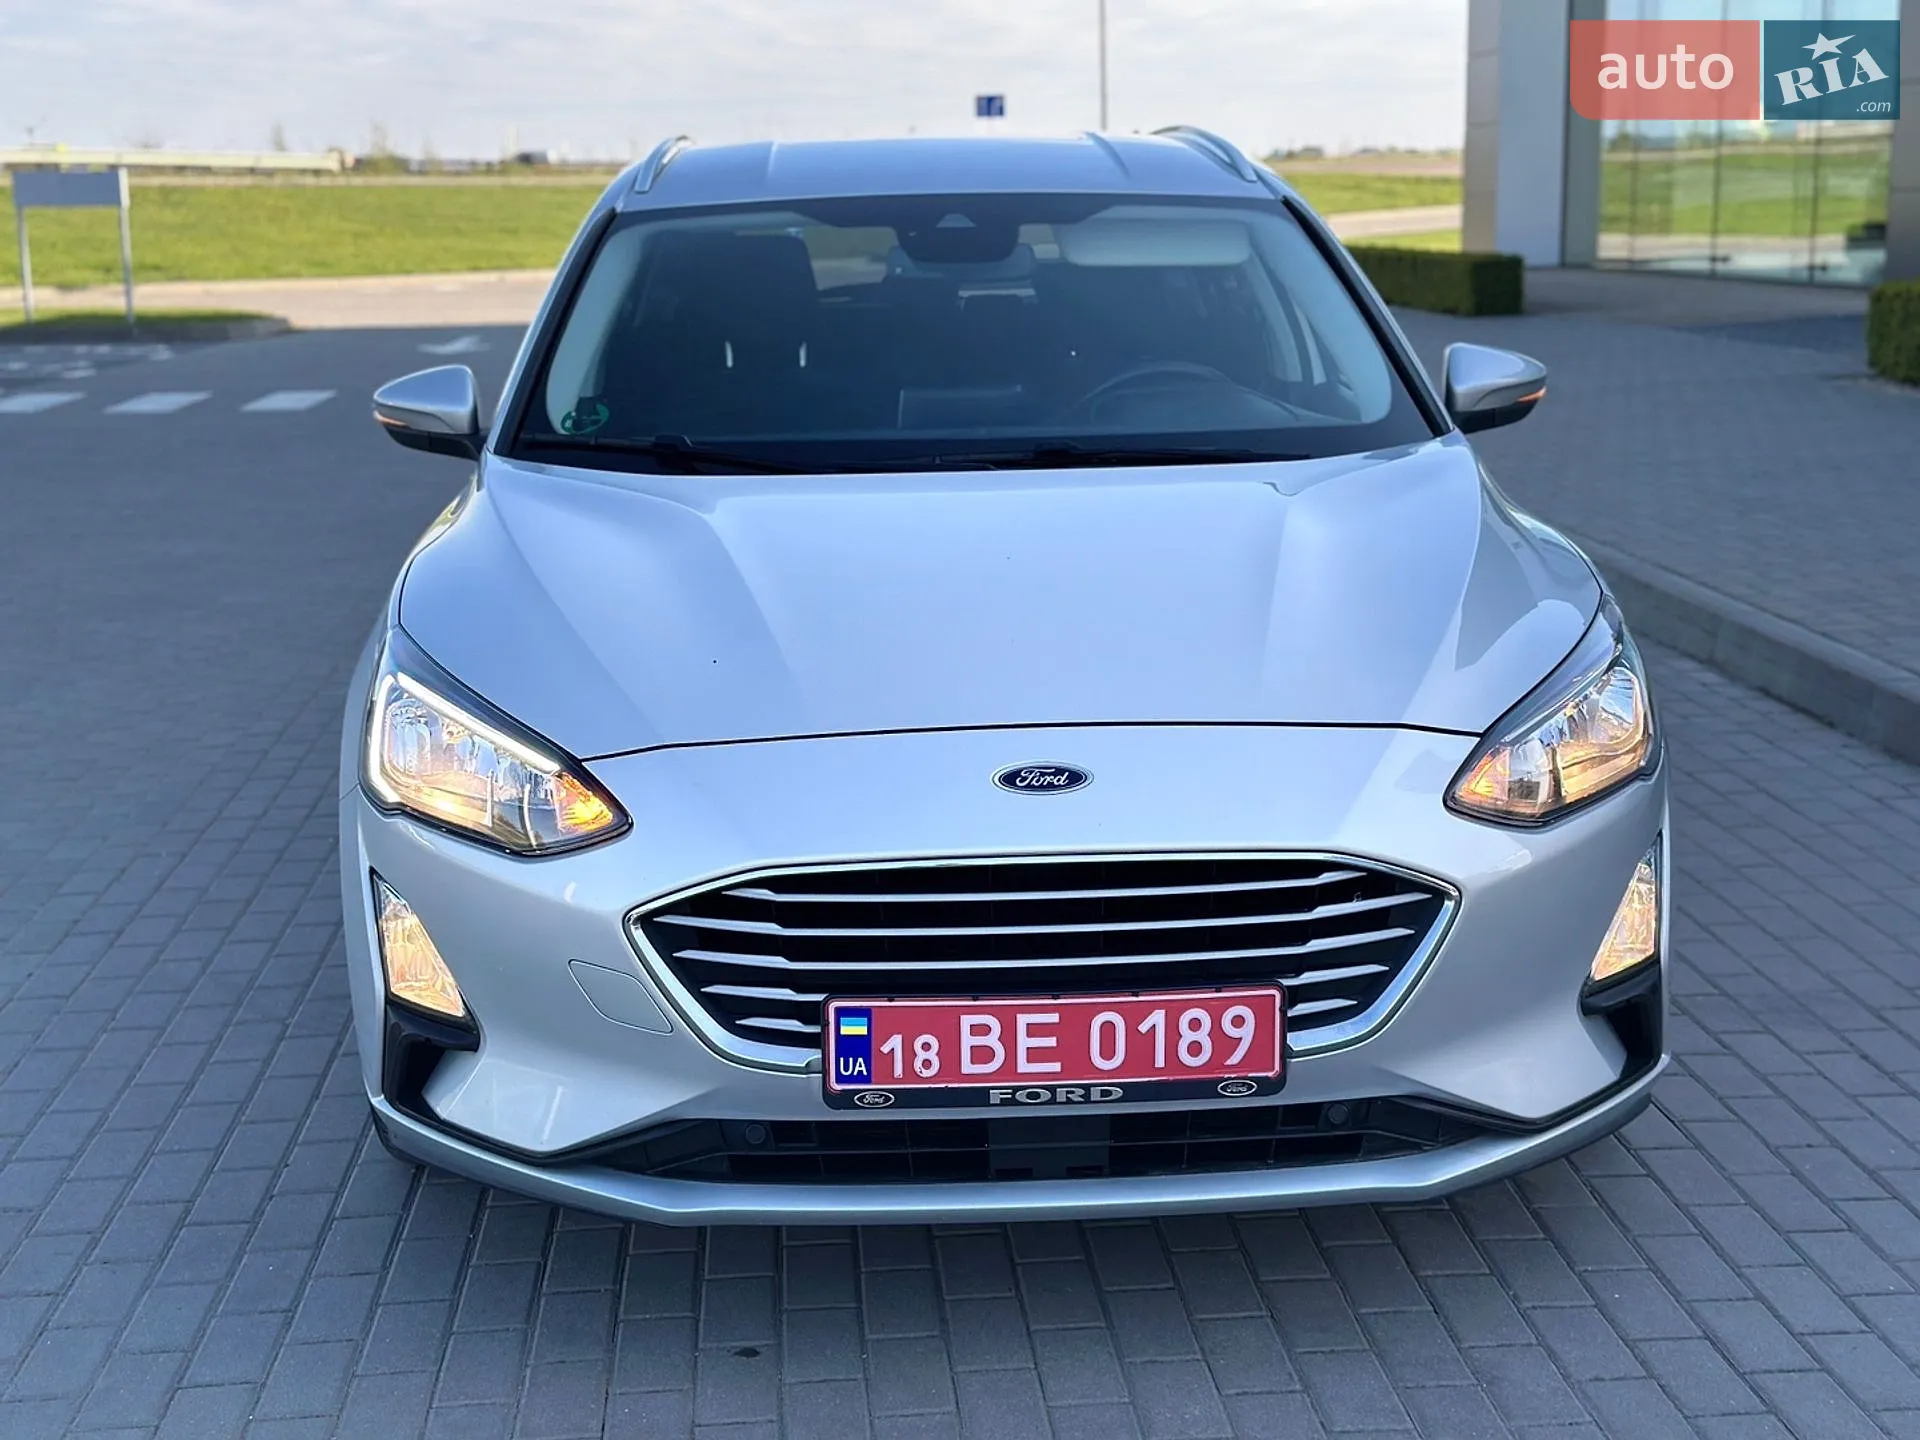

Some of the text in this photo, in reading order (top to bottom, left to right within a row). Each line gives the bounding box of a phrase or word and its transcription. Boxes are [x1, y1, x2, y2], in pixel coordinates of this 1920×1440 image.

[1016, 768, 1069, 787] Ford
[880, 1004, 1256, 1079] 18 BE 0189
[839, 1057, 868, 1076] UA
[989, 1086, 1124, 1105] FORD
